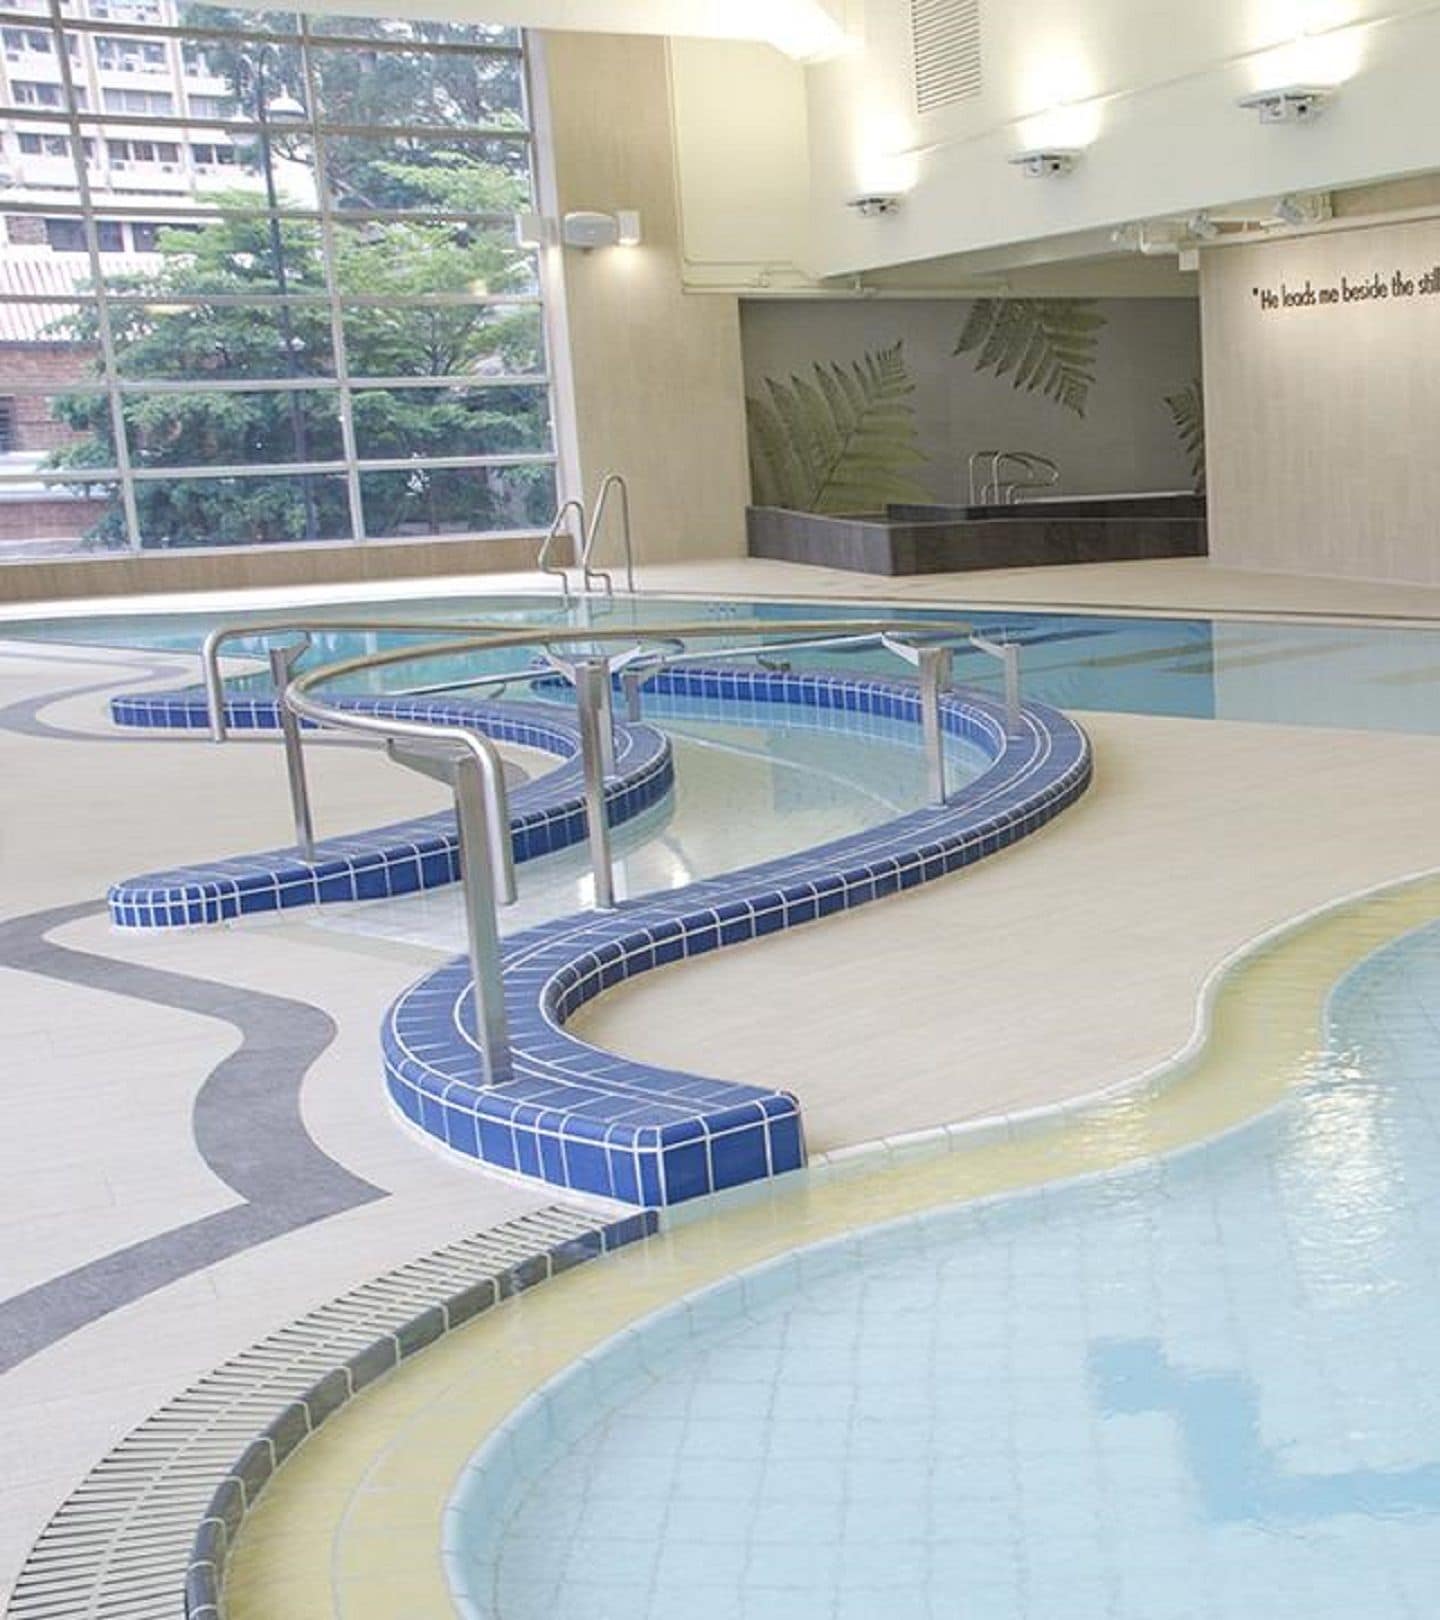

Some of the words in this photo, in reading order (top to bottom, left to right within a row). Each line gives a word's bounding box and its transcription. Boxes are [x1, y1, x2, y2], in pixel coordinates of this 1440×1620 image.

[1281, 283, 1316, 307] leads
[1319, 288, 1339, 304] me
[1342, 273, 1388, 302] beside
[1391, 269, 1414, 297] the
[1418, 266, 1440, 295] still
